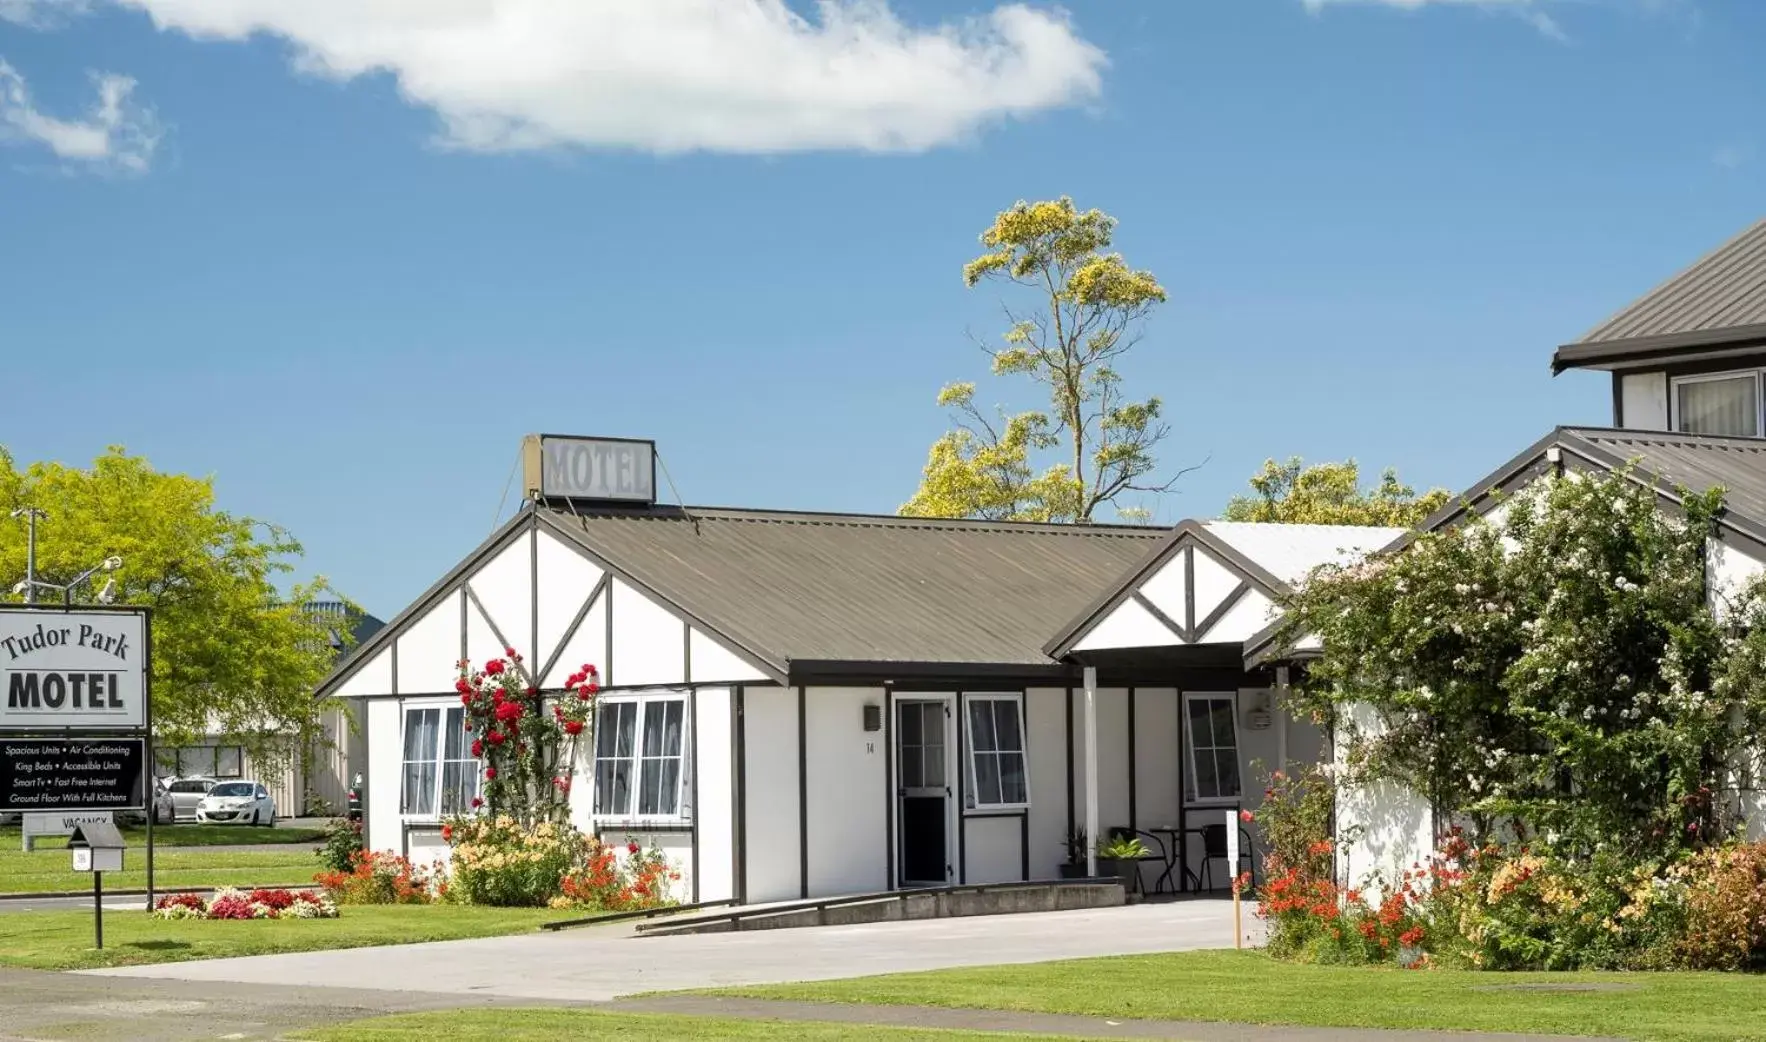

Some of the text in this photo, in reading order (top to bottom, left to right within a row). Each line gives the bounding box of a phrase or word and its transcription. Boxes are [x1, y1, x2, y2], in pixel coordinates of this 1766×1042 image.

[545, 443, 650, 495] MOTEL
[1, 624, 130, 660] Tudor Park
[8, 673, 124, 709] MOTEL
[5, 746, 130, 756] Spacious Units Air Conditioning
[866, 743, 874, 754] 14
[15, 761, 121, 773] King Beds Accessible Units
[13, 778, 117, 787] Smart Tv Fast Free Internet
[10, 793, 127, 803] Ground Floor With Full Kitchens
